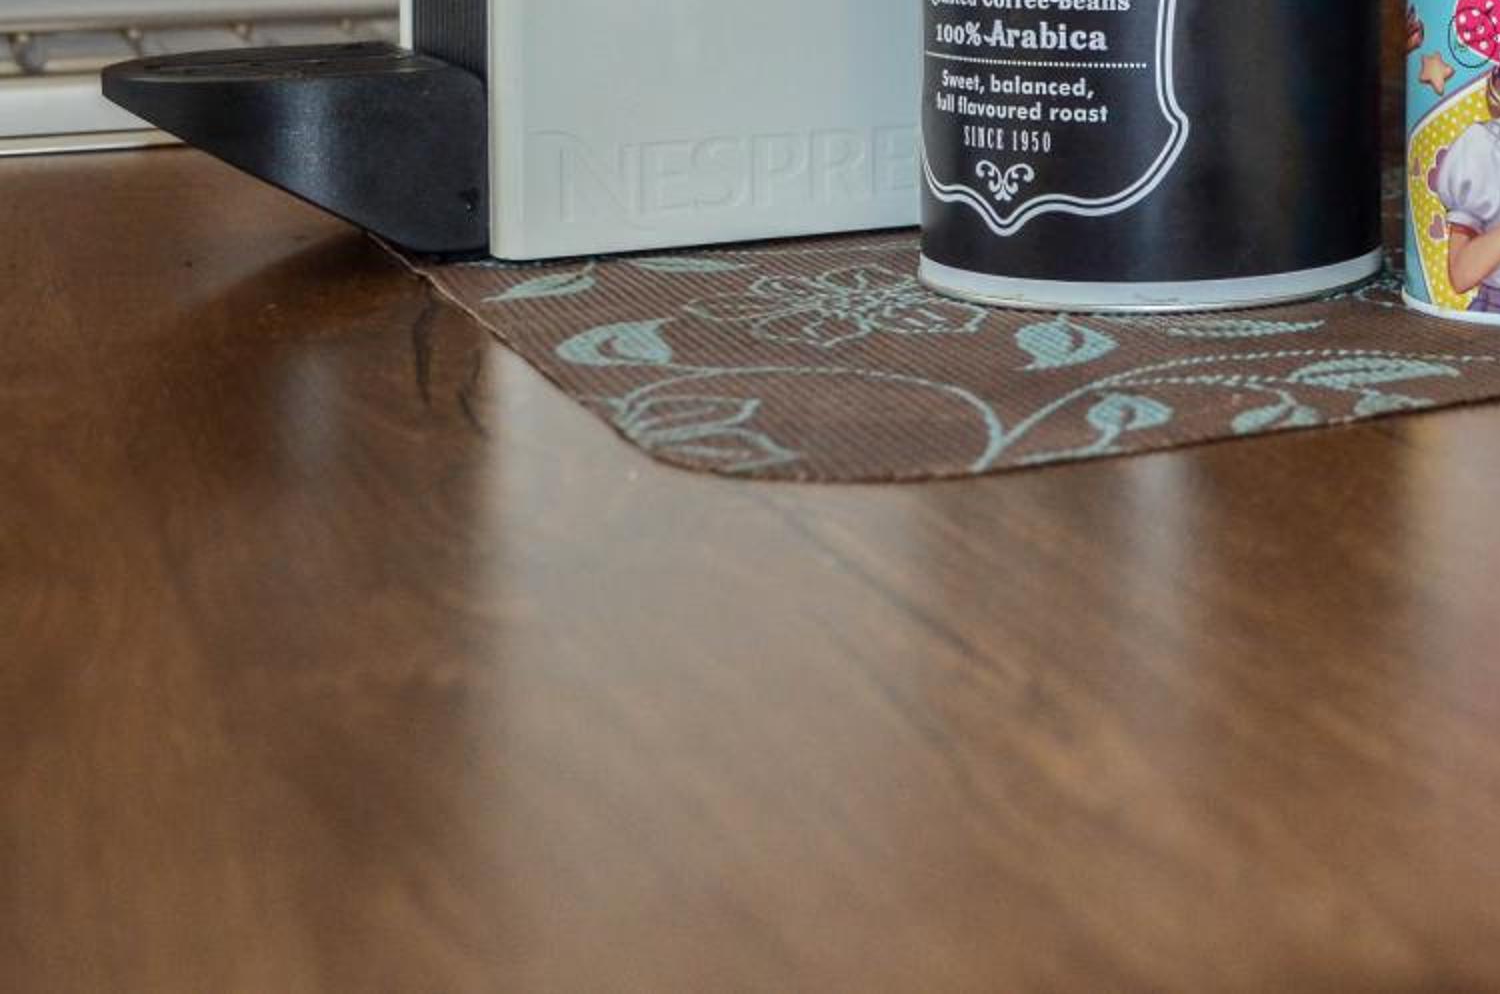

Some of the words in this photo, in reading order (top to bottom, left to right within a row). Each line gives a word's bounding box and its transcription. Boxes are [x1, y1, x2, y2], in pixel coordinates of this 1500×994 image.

[935, 22, 981, 47] 100%
[983, 19, 1108, 51] Arabica
[941, 70, 985, 94] Sweet,
[990, 73, 1094, 99] balanced,
[957, 96, 1041, 120] flavoured
[1050, 105, 1109, 123] roast
[964, 125, 1005, 150] SINCE
[1012, 129, 1051, 151] 1950
